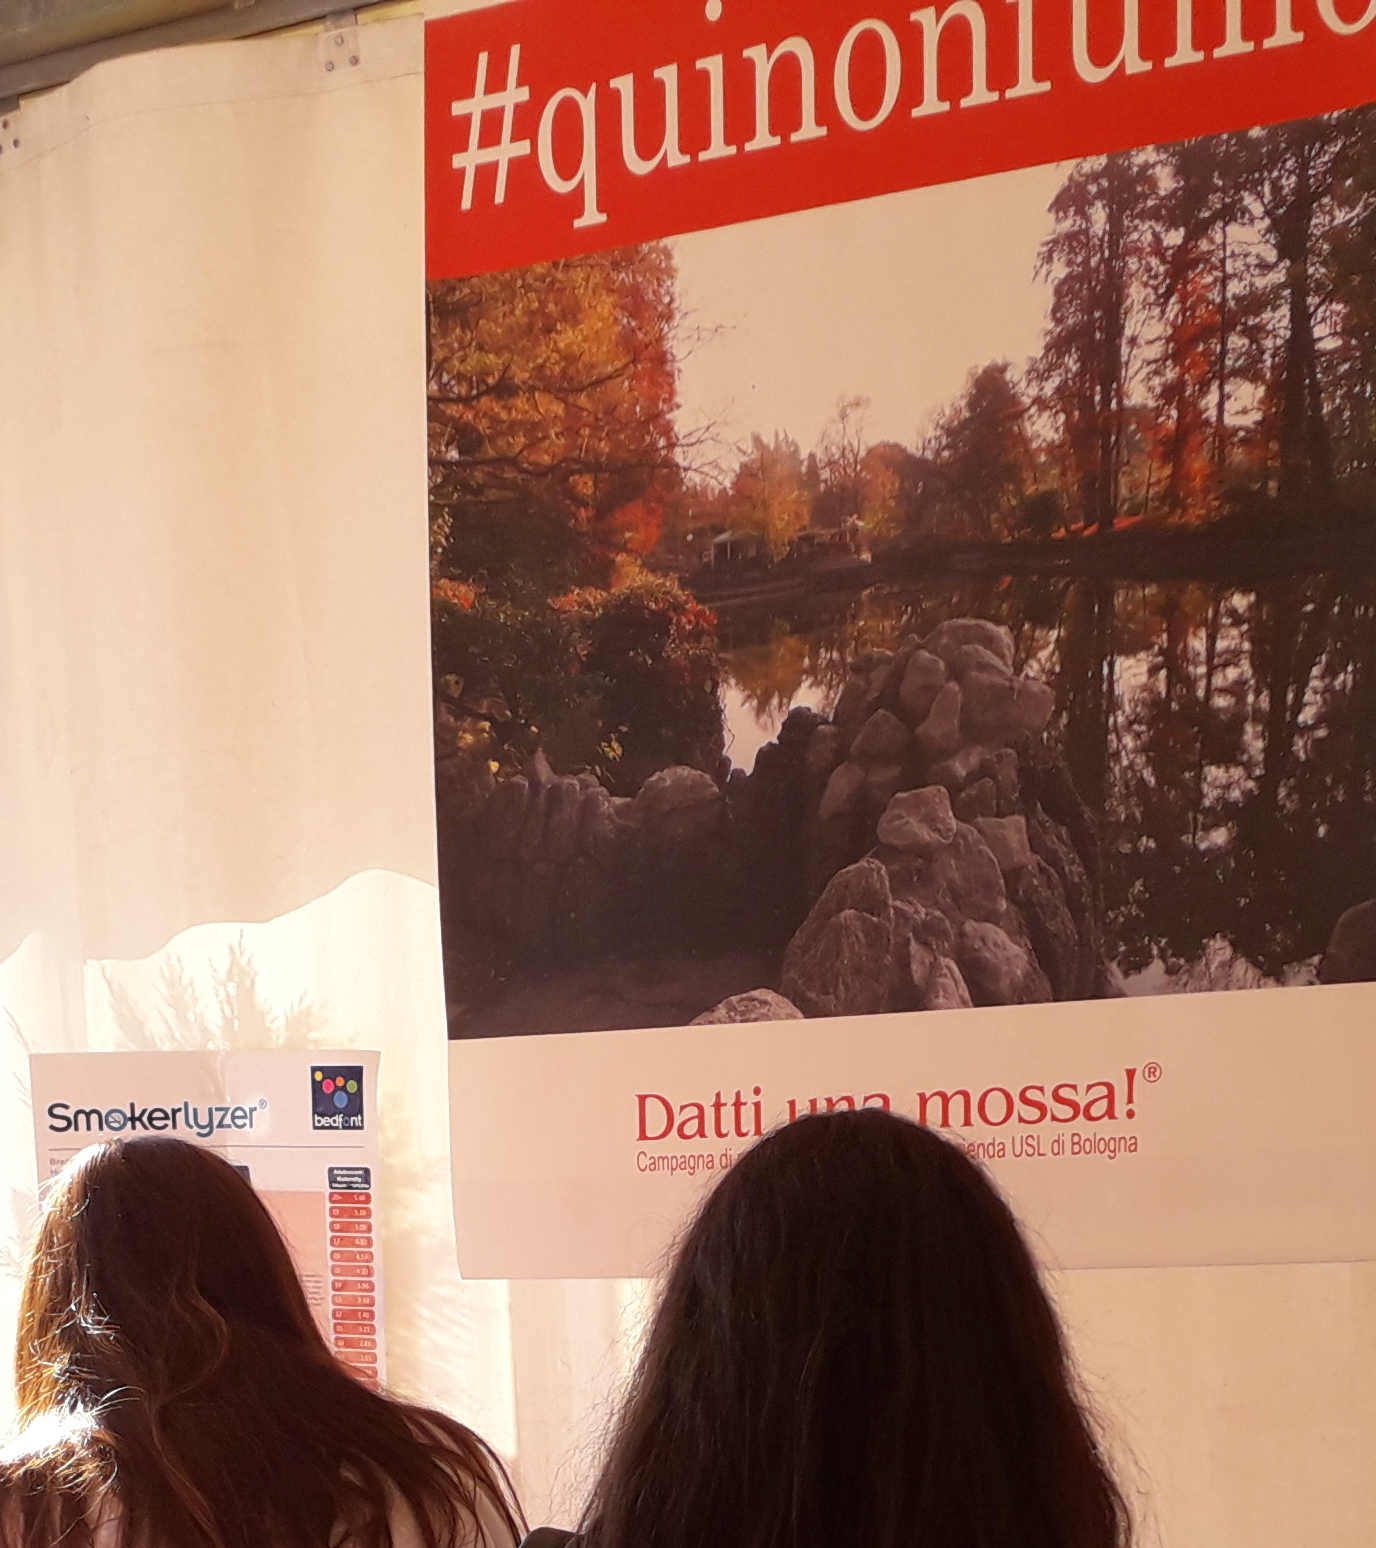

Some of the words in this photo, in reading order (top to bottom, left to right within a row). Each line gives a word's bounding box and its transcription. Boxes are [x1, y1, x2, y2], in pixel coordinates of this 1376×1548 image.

[314, 1113, 363, 1129] bedfont
[635, 1085, 764, 1142] Datti
[1012, 1135, 1048, 1158] USL
[1052, 1134, 1066, 1156] di
[1070, 1131, 1139, 1160] Bologna
[636, 1151, 713, 1177] Campagna
